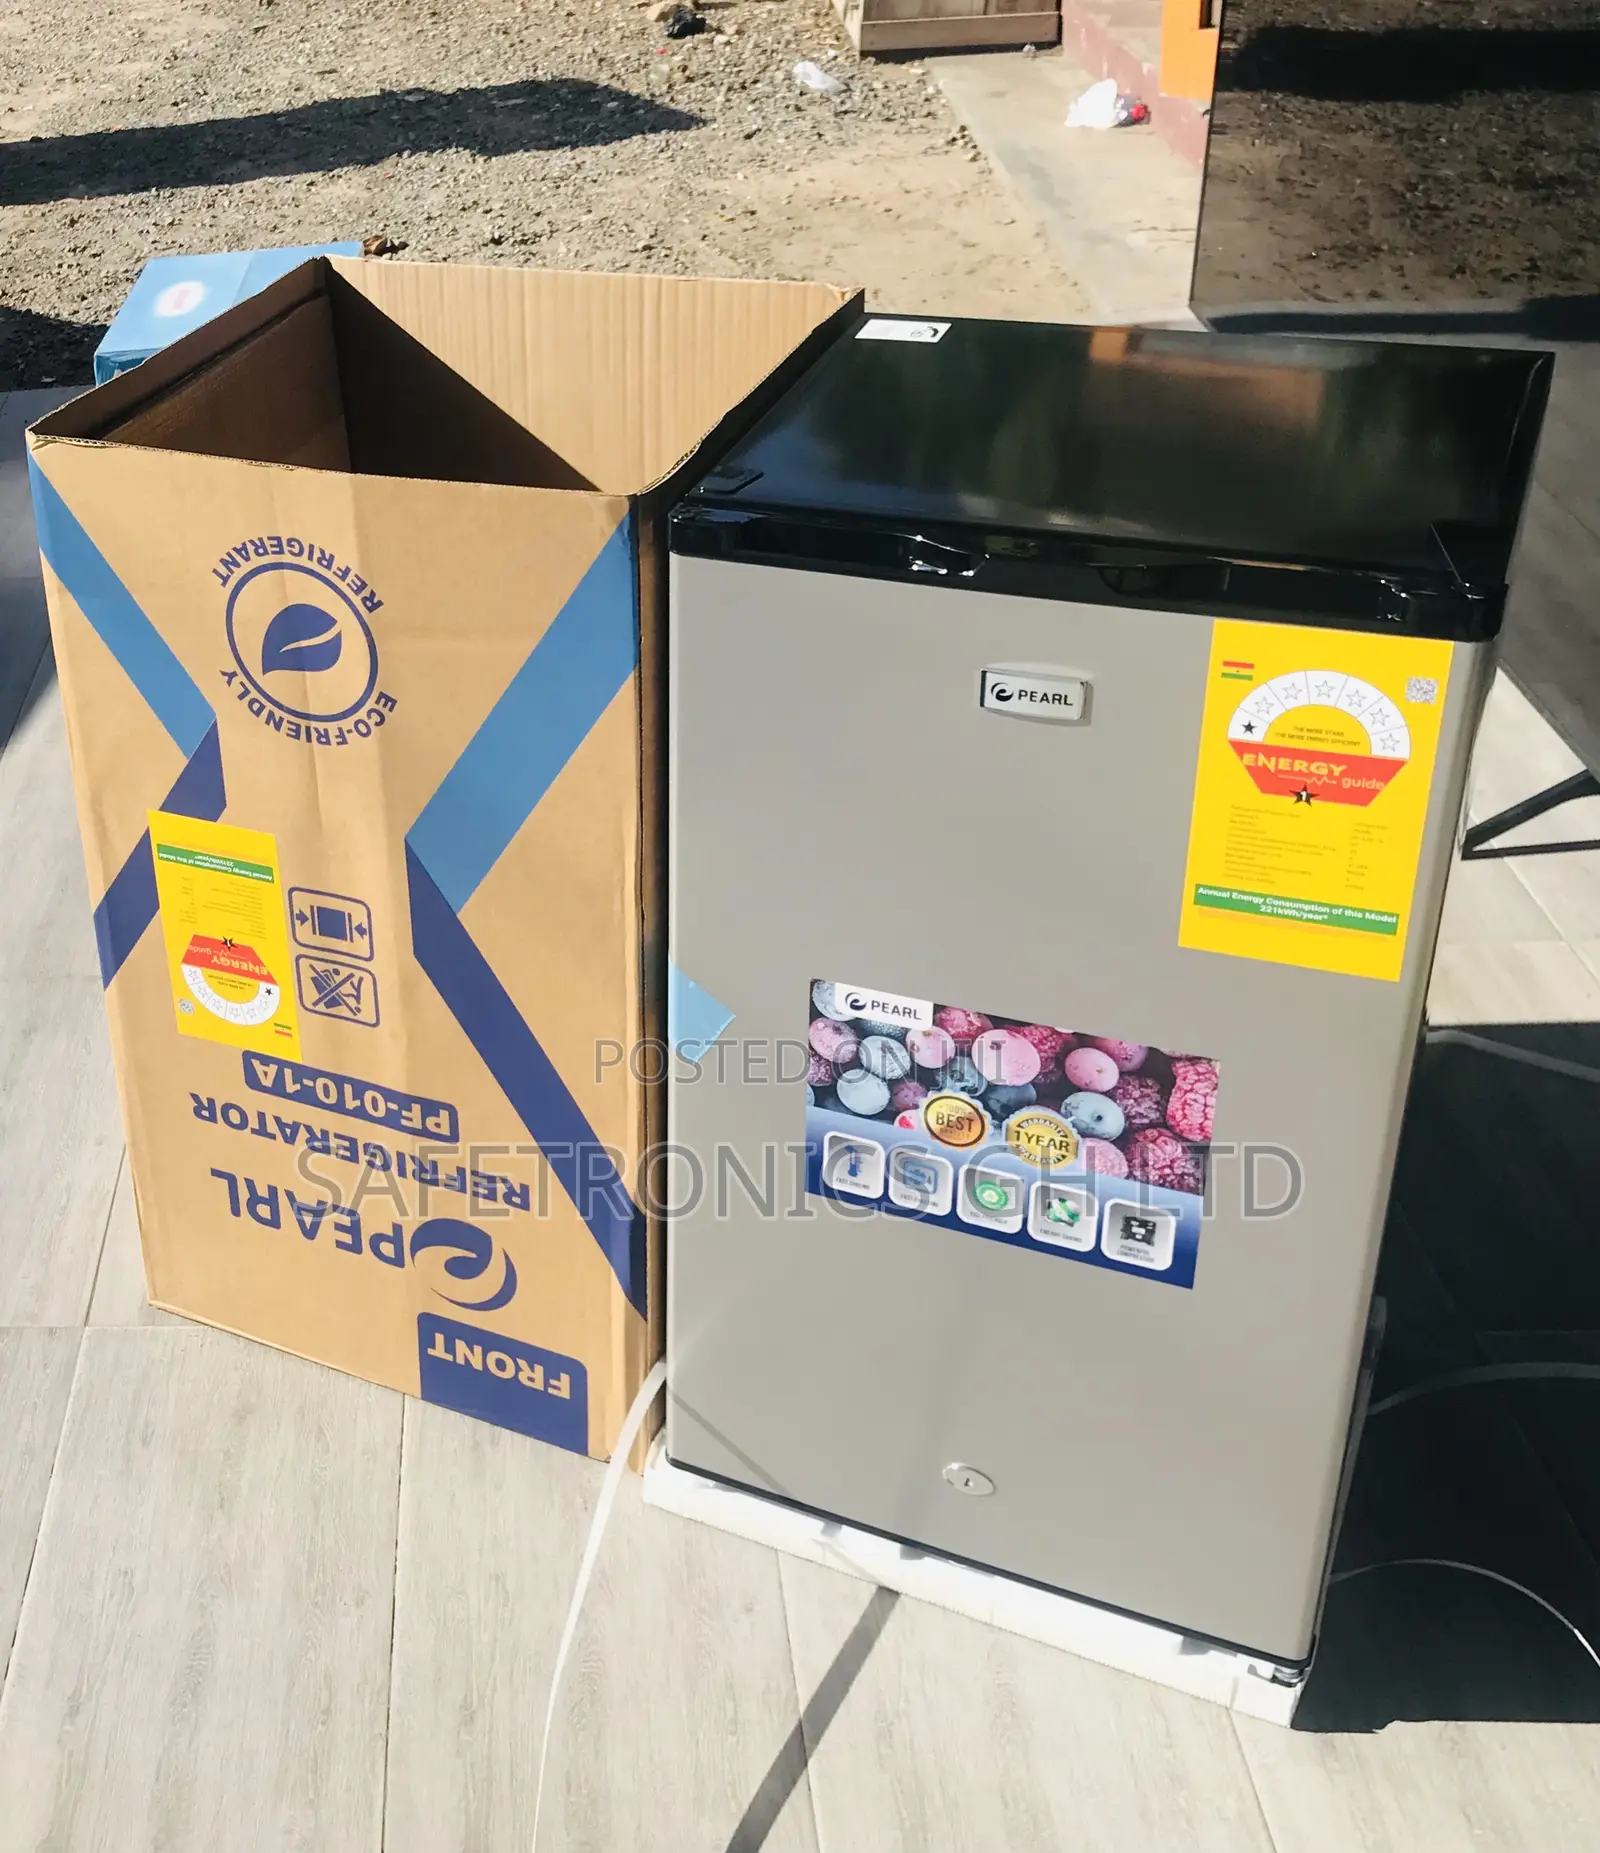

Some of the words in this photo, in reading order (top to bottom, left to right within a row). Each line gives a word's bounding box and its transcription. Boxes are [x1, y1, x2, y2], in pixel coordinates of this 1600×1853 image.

[212, 536, 384, 614] REFRIGERANT
[220, 669, 397, 746] ECO-FRIENDLY
[1018, 689, 1074, 706] PEARL
[1341, 776, 1385, 791] guide
[1198, 886, 1230, 899] Annual
[1231, 892, 1264, 905] Energy
[1266, 896, 1331, 915] Consumption
[1332, 906, 1344, 916] of
[1345, 908, 1364, 919] this
[1365, 912, 1397, 924] Model
[870, 1000, 923, 1021] PEARL
[250, 1058, 451, 1137] PF-010-1A
[935, 1111, 975, 1133] BEST
[189, 1092, 531, 1212] REFRIGERATOR
[1014, 1130, 1022, 1141] 1
[1024, 1132, 1071, 1153] YEAR
[210, 1168, 406, 1269] PEARL
[428, 1333, 571, 1400] FRONT
